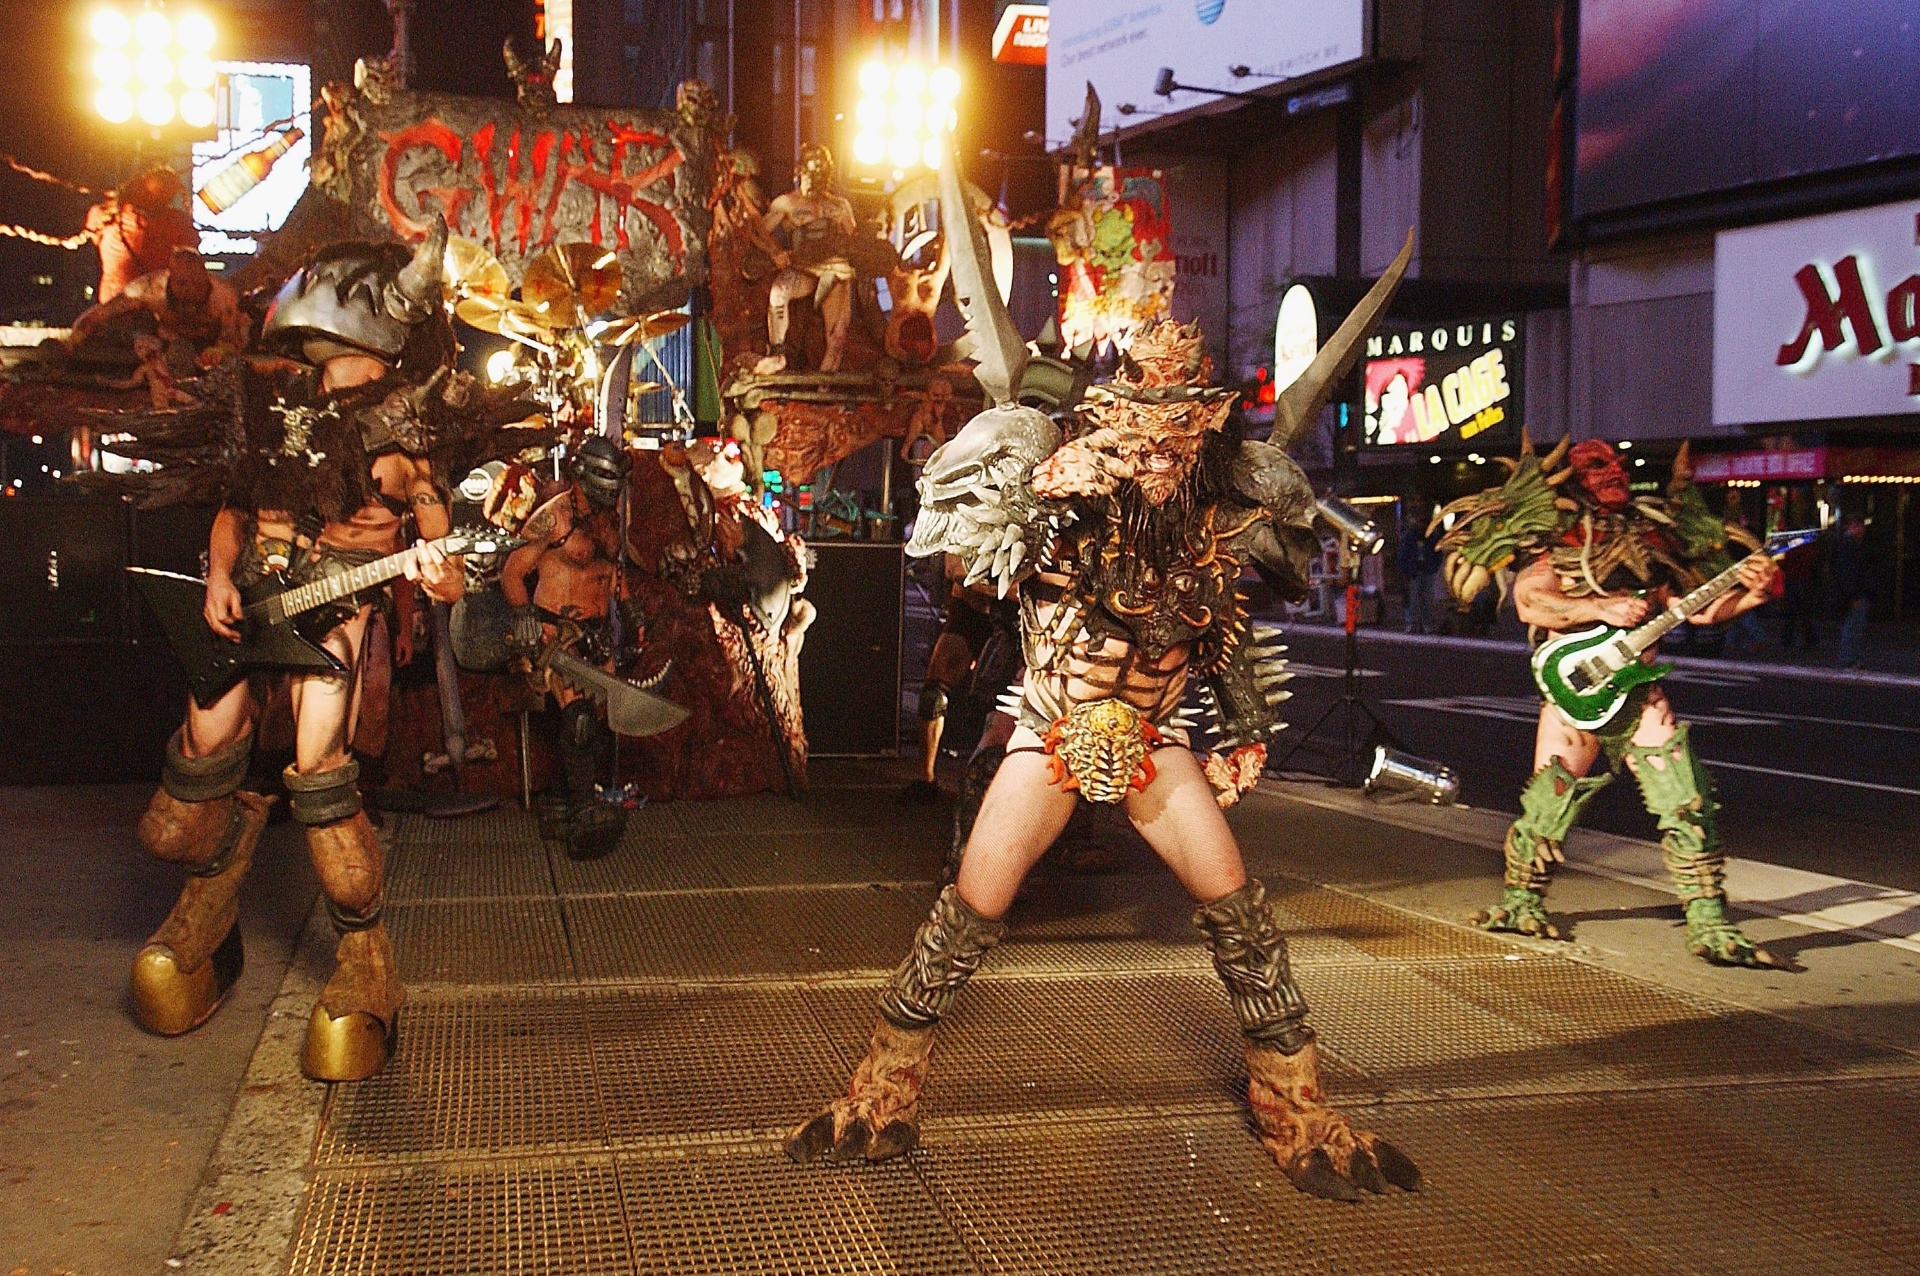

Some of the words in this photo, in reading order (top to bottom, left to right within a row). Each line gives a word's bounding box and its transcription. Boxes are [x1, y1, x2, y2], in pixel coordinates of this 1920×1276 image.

[1366, 319, 1517, 357] MARQUIS
[1410, 383, 1450, 442] LA
[1441, 347, 1511, 425] CAGE
